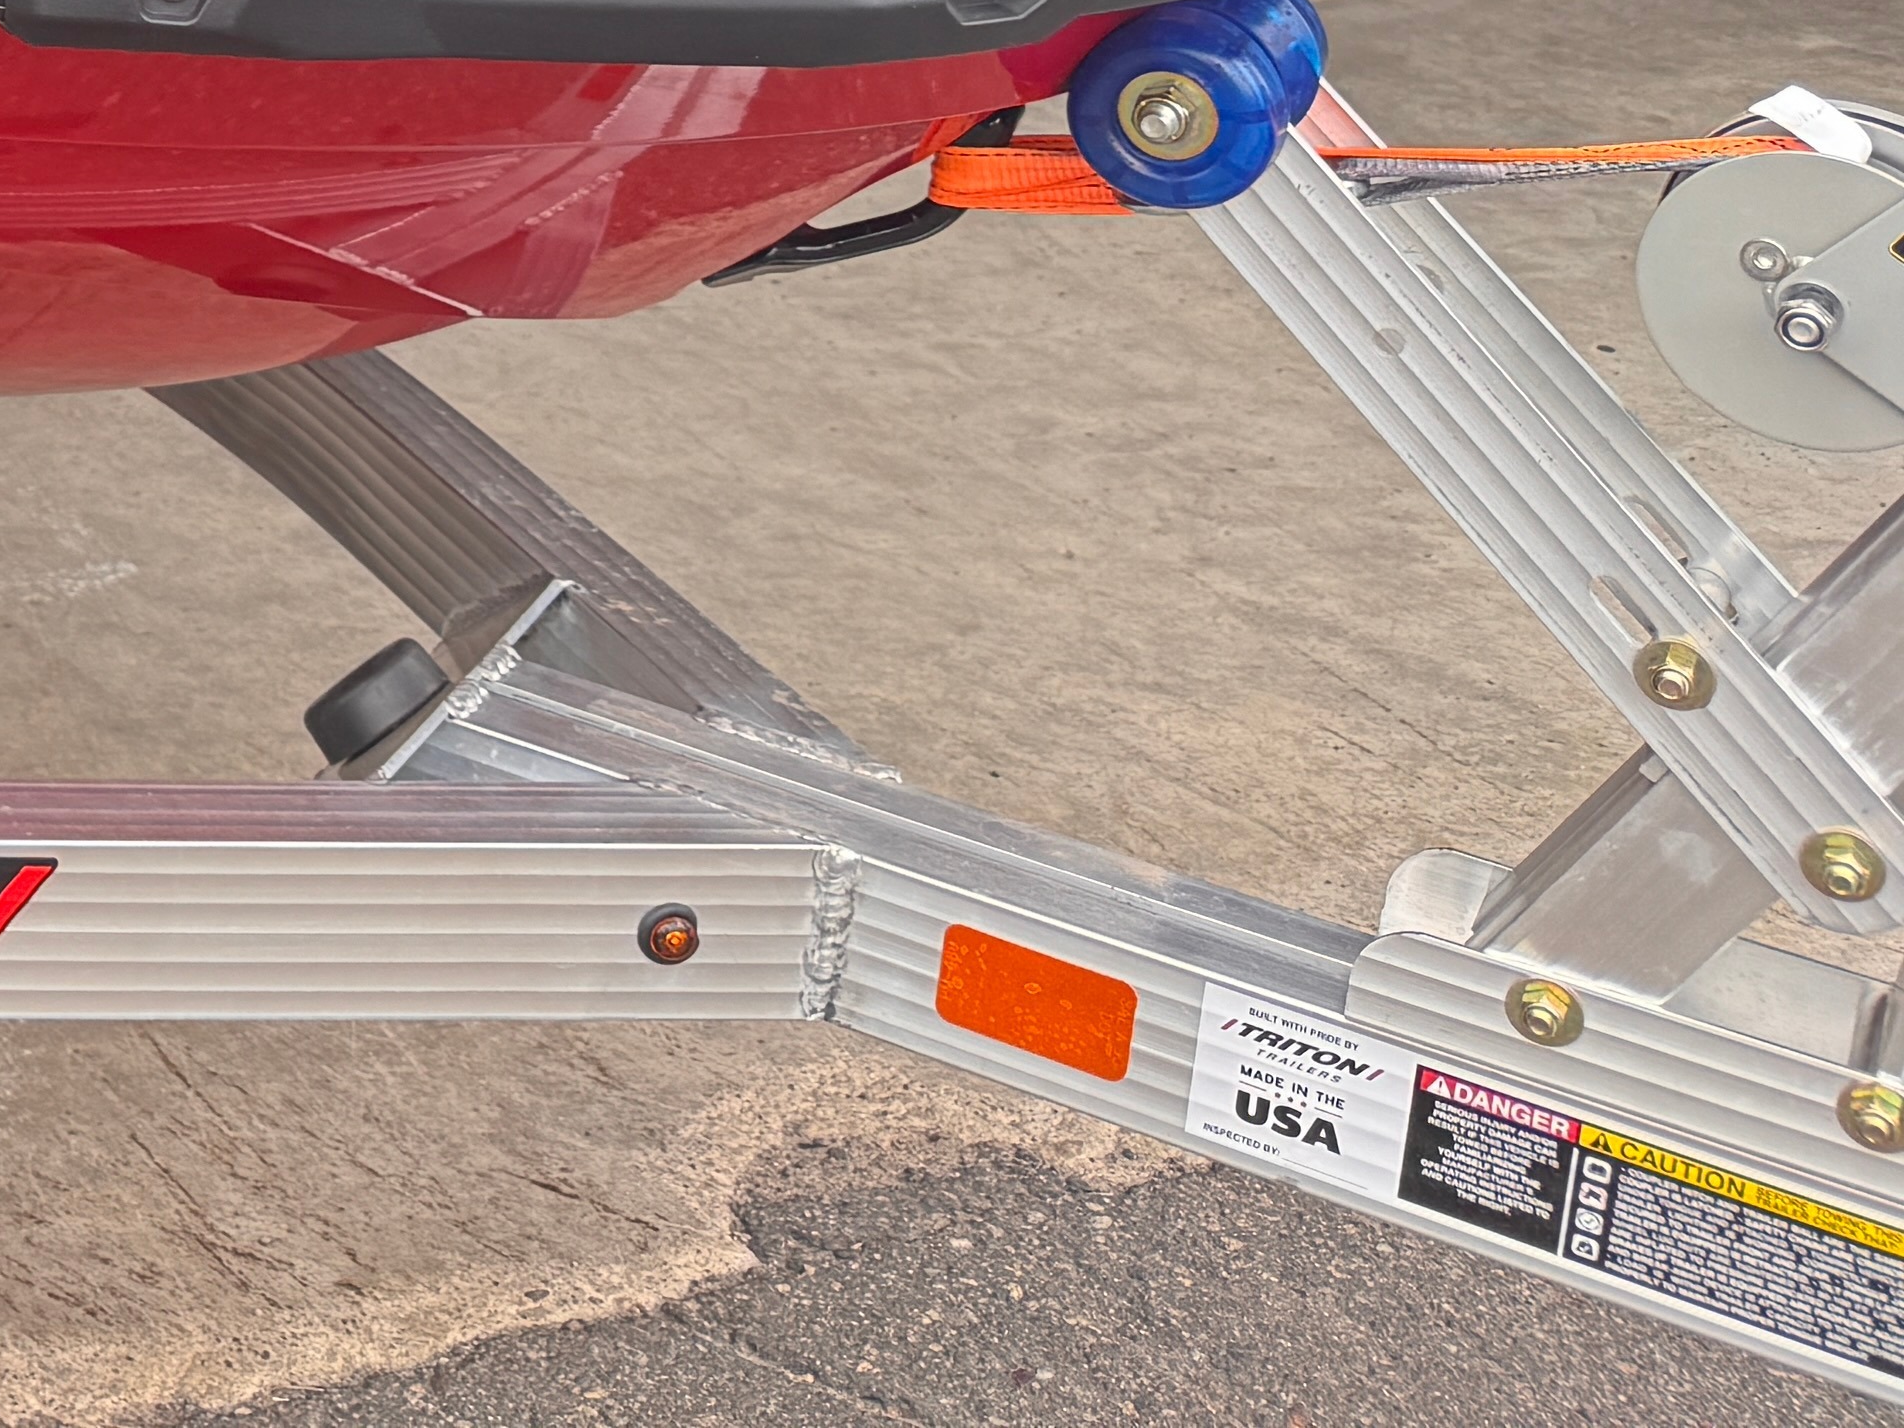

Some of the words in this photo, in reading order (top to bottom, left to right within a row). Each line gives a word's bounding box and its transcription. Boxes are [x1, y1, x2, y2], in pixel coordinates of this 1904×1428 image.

[1239, 1022, 1370, 1076] TRITON
[1249, 1007, 1278, 1024] BUILT
[1281, 1018, 1307, 1034] WITH
[1310, 1027, 1342, 1046] PRIDE
[1345, 1040, 1359, 1051] BY
[1240, 1065, 1285, 1089] MADE
[1292, 1083, 1308, 1097] IN
[1316, 1091, 1345, 1110] THE
[1257, 1048, 1342, 1084] TRAILERS
[1235, 1090, 1341, 1156] USA
[1427, 1115, 1465, 1136] RESULT
[1432, 1108, 1486, 1134] PROPERTY
[1452, 1081, 1570, 1140] DANGER
[1203, 1122, 1261, 1149] INSPECTED
[1620, 1142, 1746, 1199] CAUTION
[1755, 1193, 1809, 1221] TRAILER
[1813, 1214, 1859, 1238] CHECK
[1756, 1184, 1808, 1212] BEFORE
[1815, 1205, 1867, 1232] TOWING
